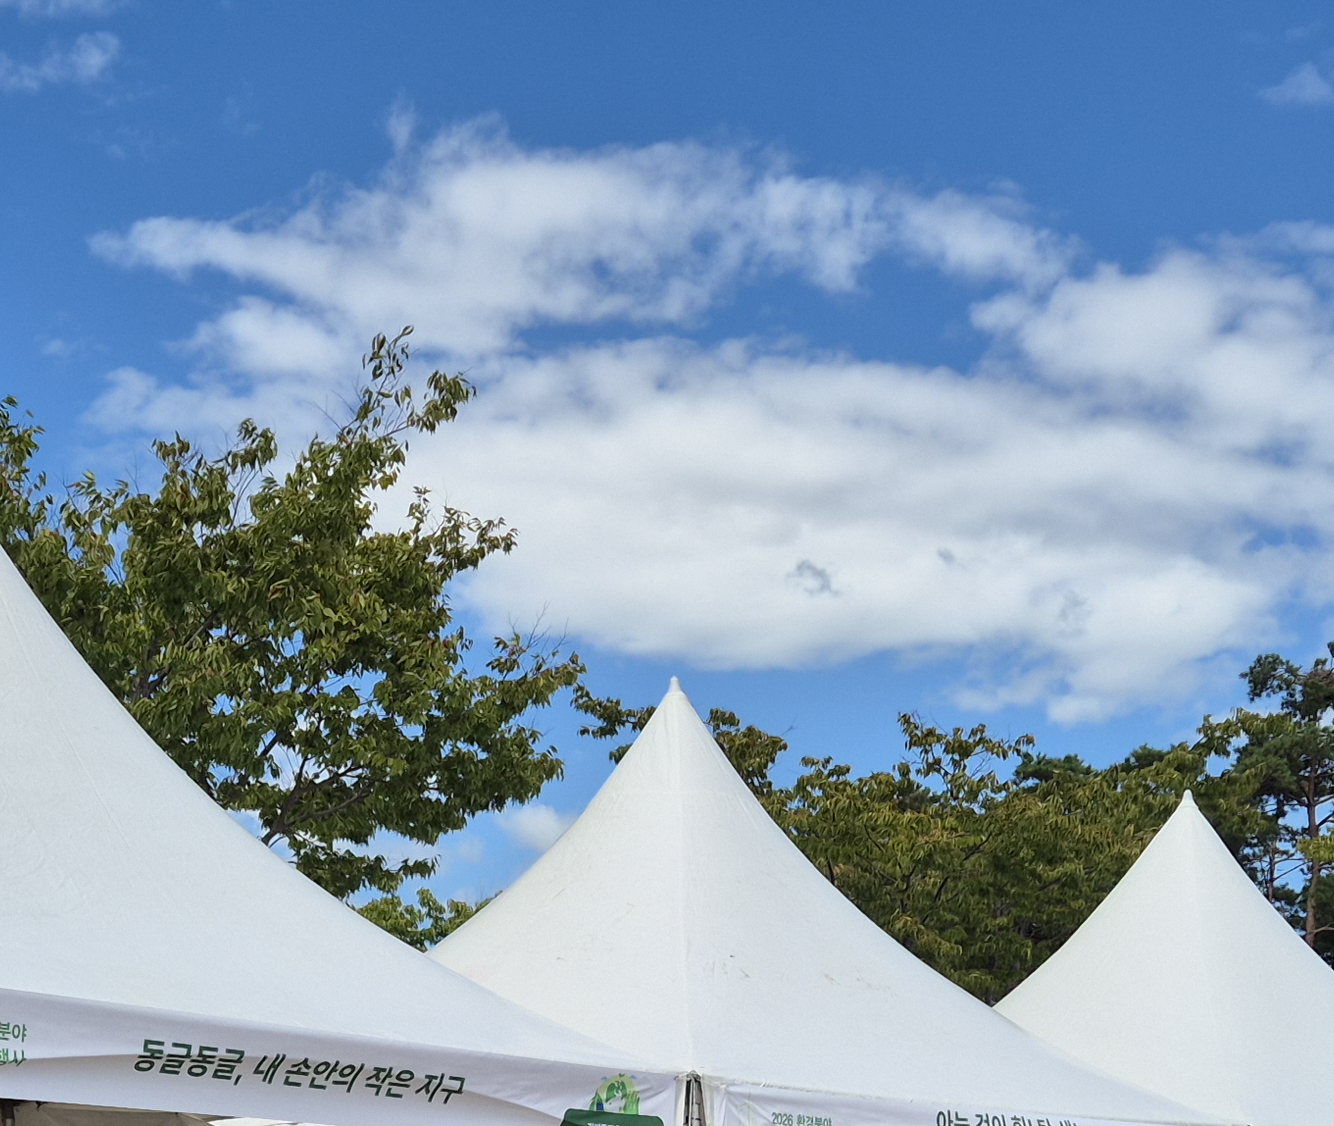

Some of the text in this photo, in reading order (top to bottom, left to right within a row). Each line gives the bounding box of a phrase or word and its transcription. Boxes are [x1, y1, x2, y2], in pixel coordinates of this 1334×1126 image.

[133, 1039, 466, 1105] 동글동글, 내 손안의 작은 지구
[771, 1112, 794, 1126] 2026
